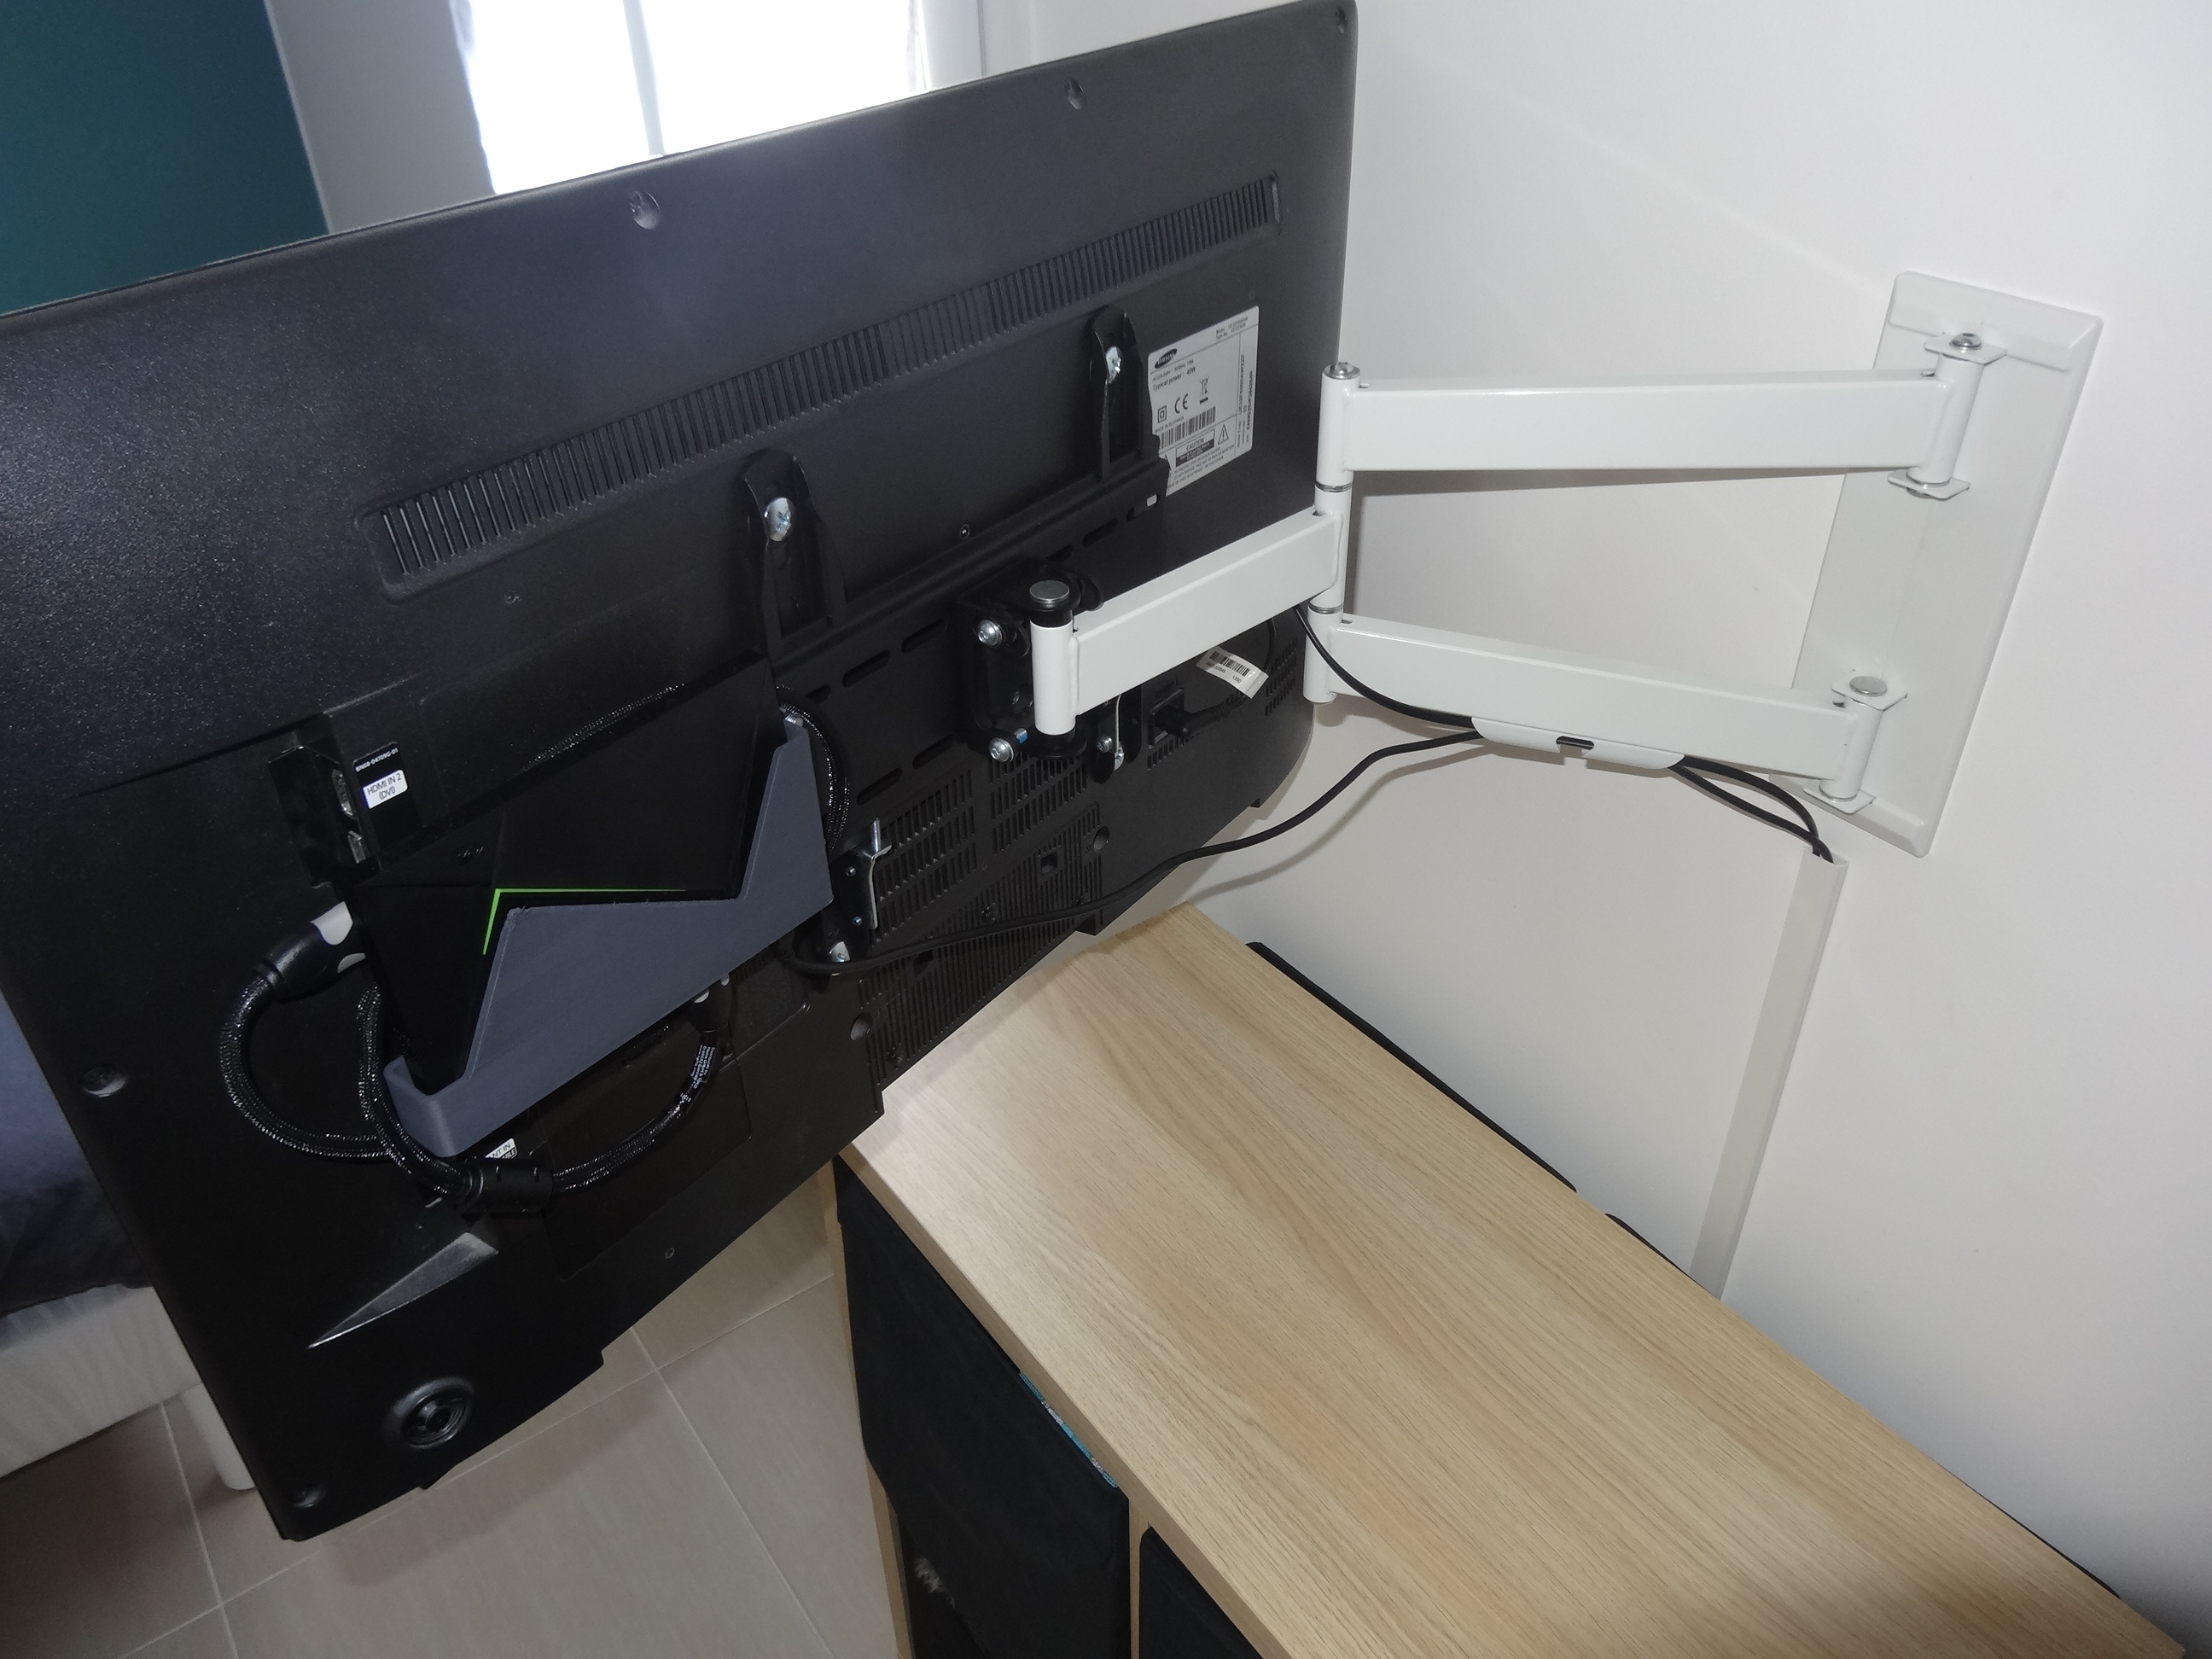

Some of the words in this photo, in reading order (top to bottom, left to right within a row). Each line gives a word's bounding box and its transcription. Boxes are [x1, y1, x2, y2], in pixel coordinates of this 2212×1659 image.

[1186, 438, 1205, 451] CAUTION
[367, 779, 387, 795] HDMI
[387, 776, 396, 785] IN
[397, 772, 403, 782] 2
[379, 786, 397, 800] (DVI)
